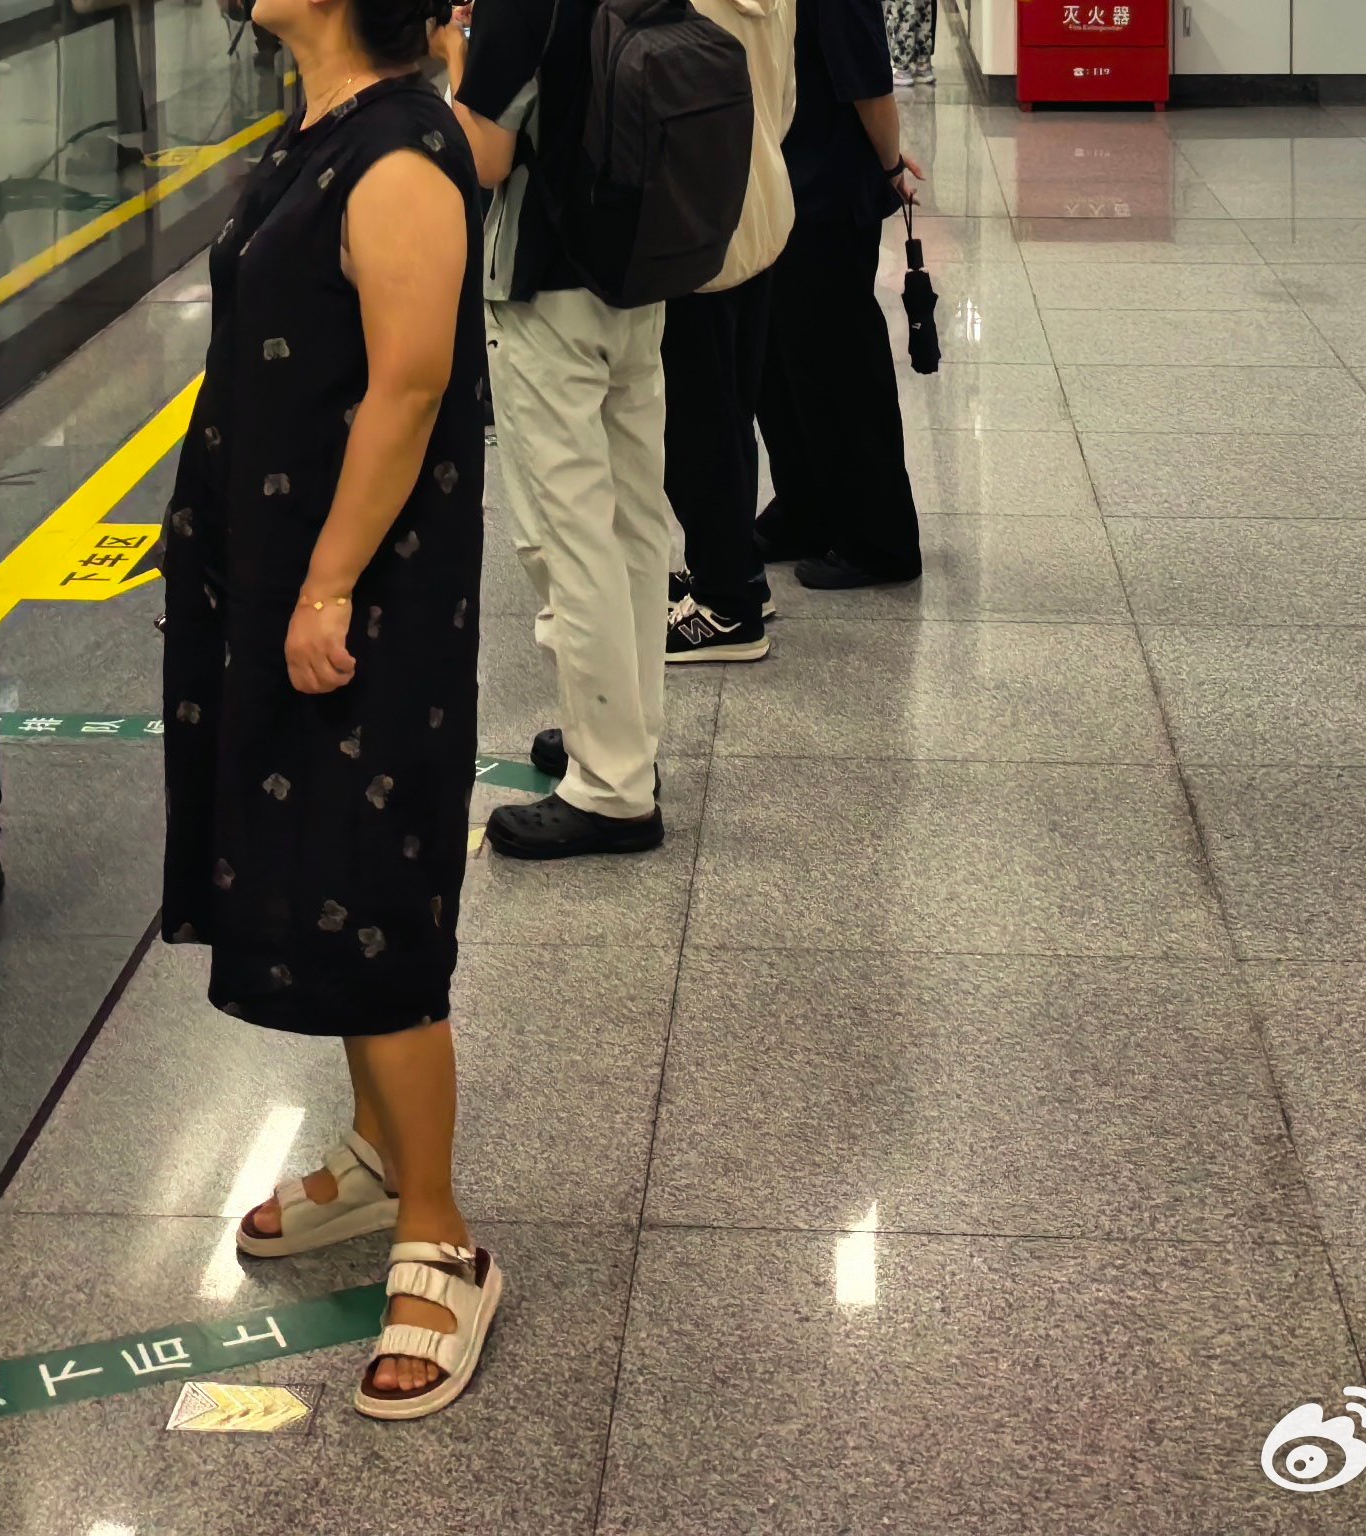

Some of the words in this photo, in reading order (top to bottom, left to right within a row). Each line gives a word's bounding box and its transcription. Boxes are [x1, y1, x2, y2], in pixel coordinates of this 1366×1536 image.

[1063, 5, 1130, 25] 灭火器
[59, 535, 148, 587] 下车区
